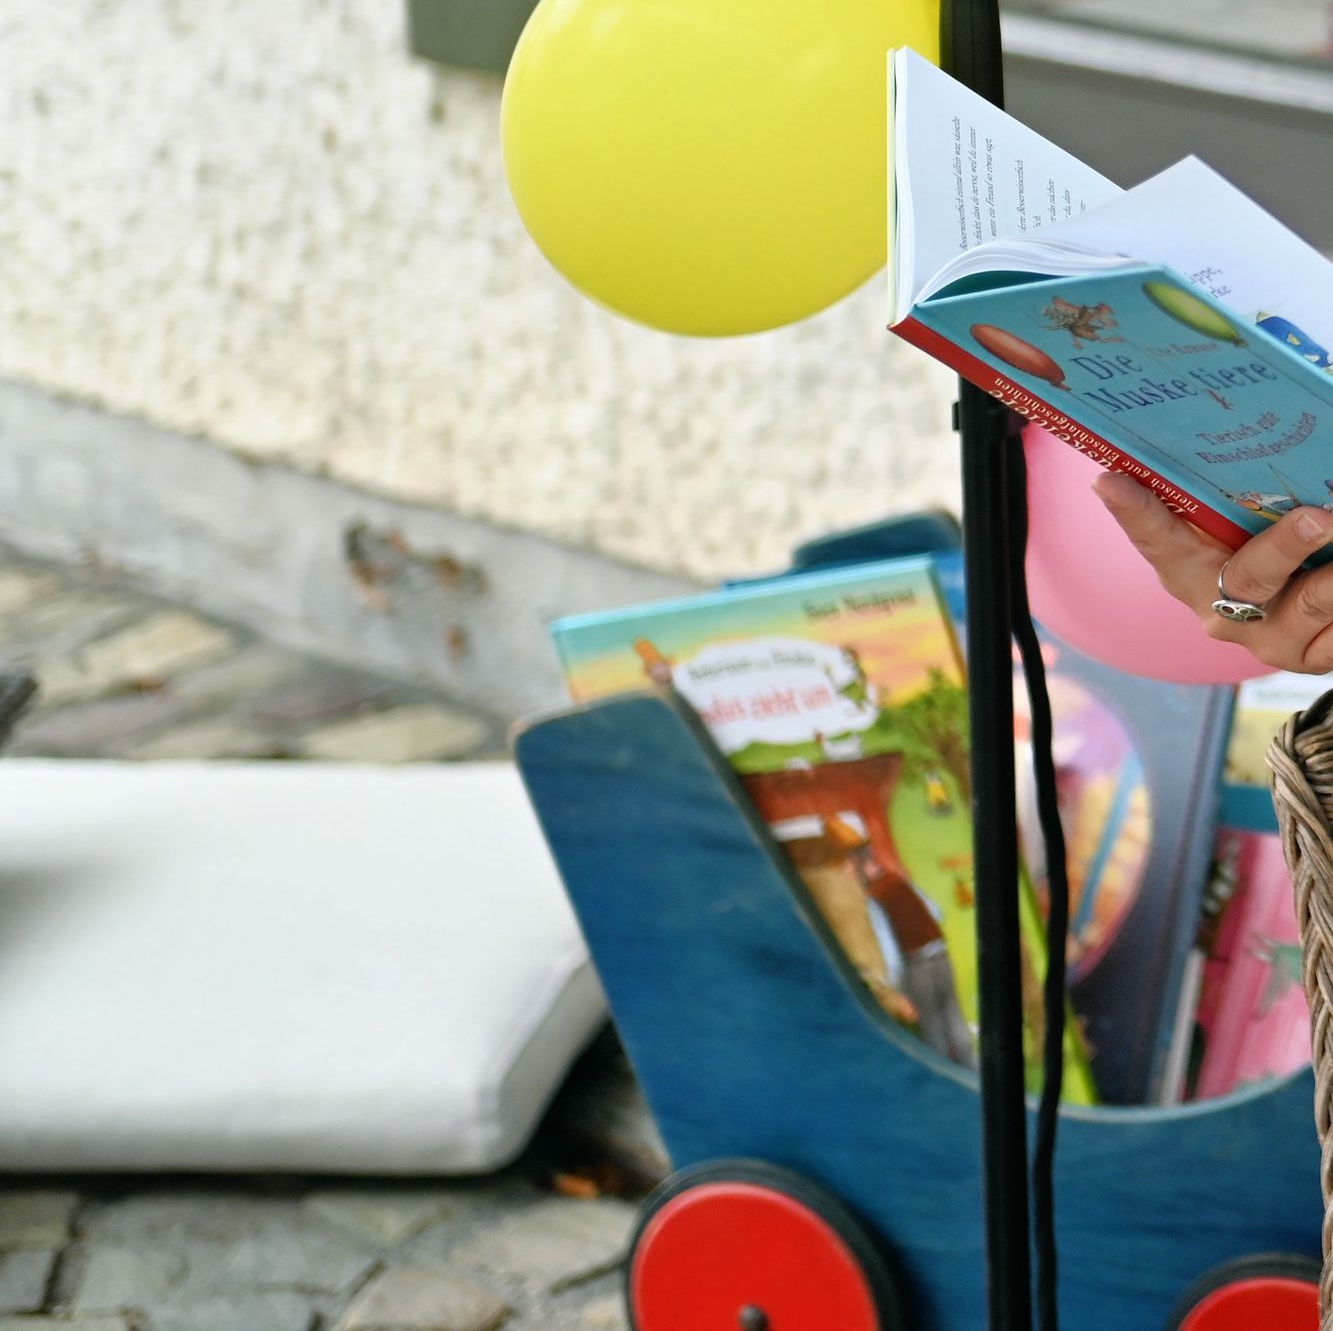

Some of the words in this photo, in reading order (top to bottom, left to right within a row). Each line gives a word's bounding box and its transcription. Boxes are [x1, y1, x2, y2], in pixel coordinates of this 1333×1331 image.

[1070, 354, 1143, 381] Die
[994, 376, 1120, 463] Einschlafgeschichten
[1121, 460, 1151, 478] gute
[1151, 476, 1200, 515] Tierisch
